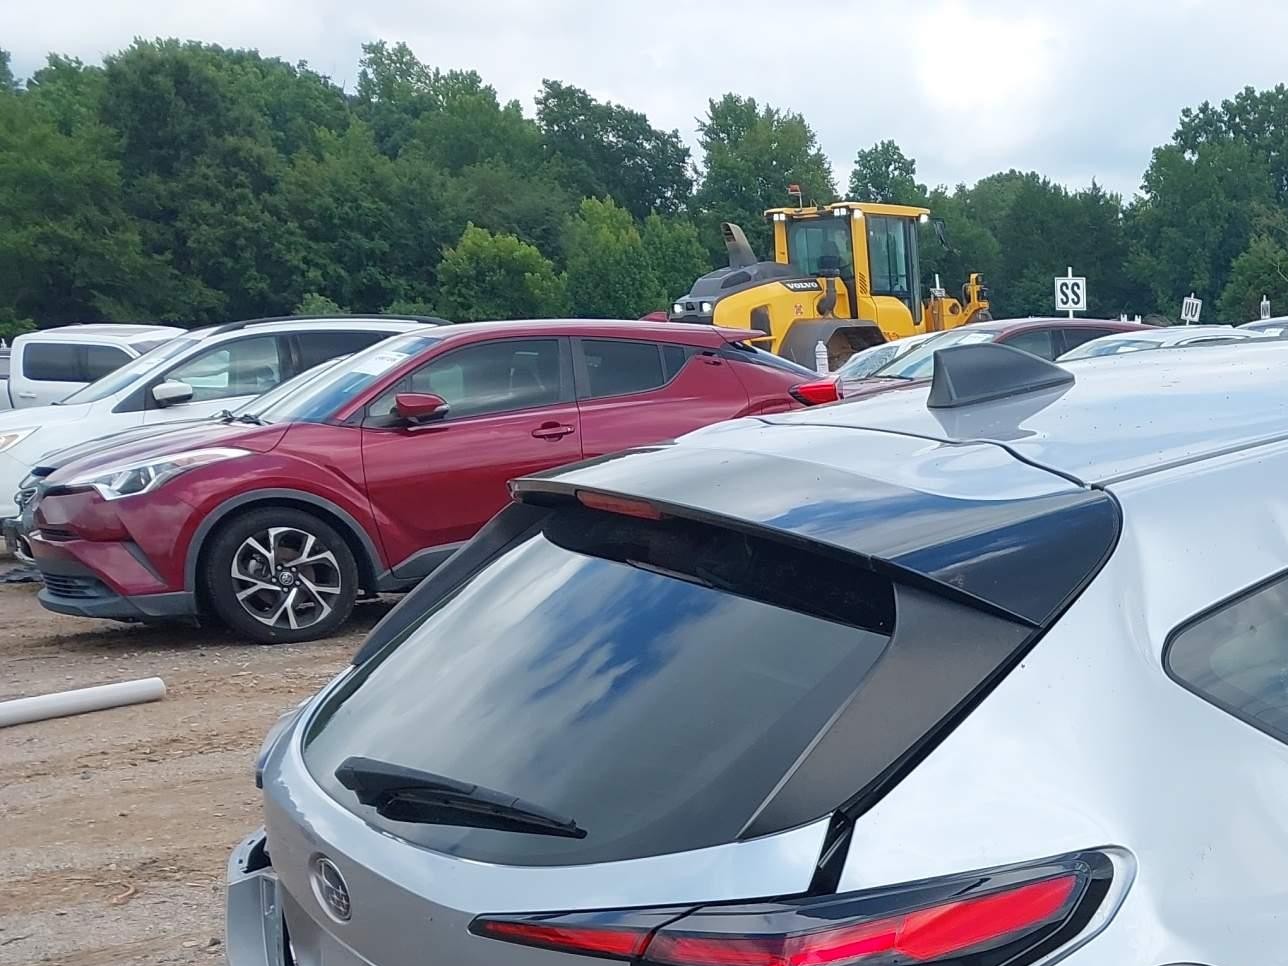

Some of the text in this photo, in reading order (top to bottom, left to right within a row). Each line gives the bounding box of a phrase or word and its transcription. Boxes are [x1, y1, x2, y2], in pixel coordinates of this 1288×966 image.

[785, 281, 818, 289] VOLVO
[1059, 281, 1081, 306] SS
[1184, 301, 1199, 318] UU
